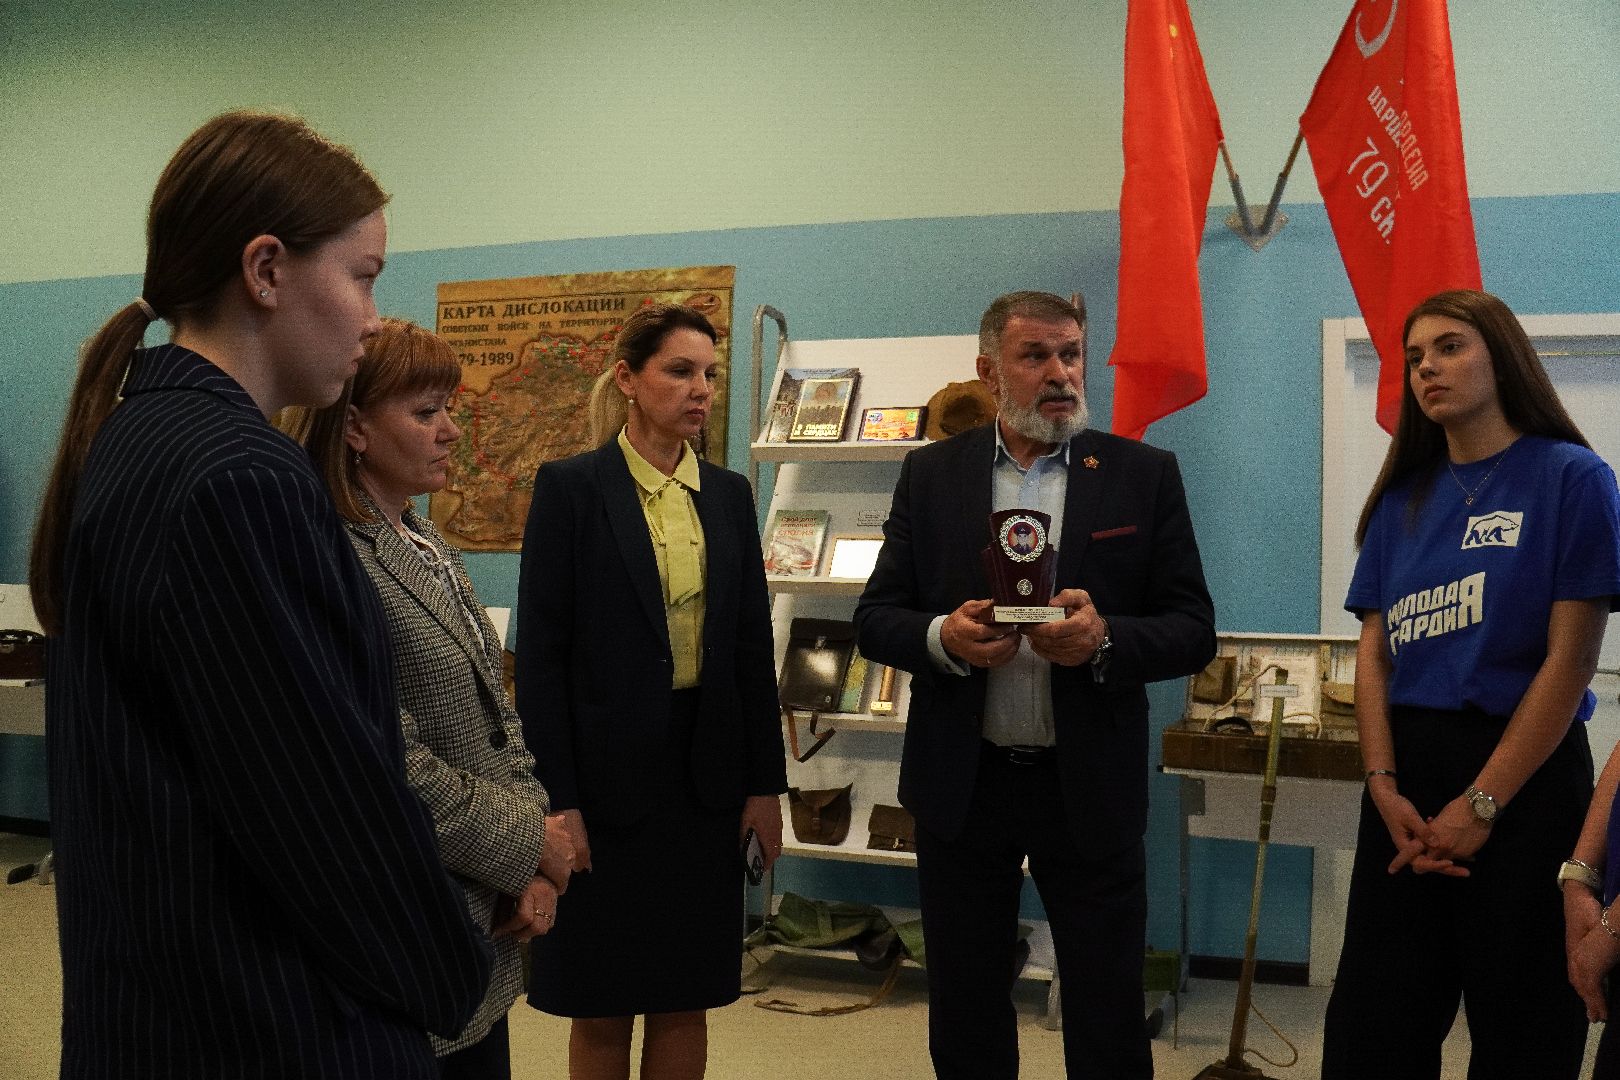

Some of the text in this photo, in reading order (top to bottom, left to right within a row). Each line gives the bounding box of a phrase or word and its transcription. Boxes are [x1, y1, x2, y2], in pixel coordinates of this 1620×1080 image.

[1347, 136, 1389, 198] 79
[442, 298, 625, 320] КАРТА ДИСЛОКАЦИИ
[441, 317, 624, 333] СОВЕТСКИХ ВОЙСК НА ТЕРРИТОРИИ
[458, 352, 514, 366] 79-1989
